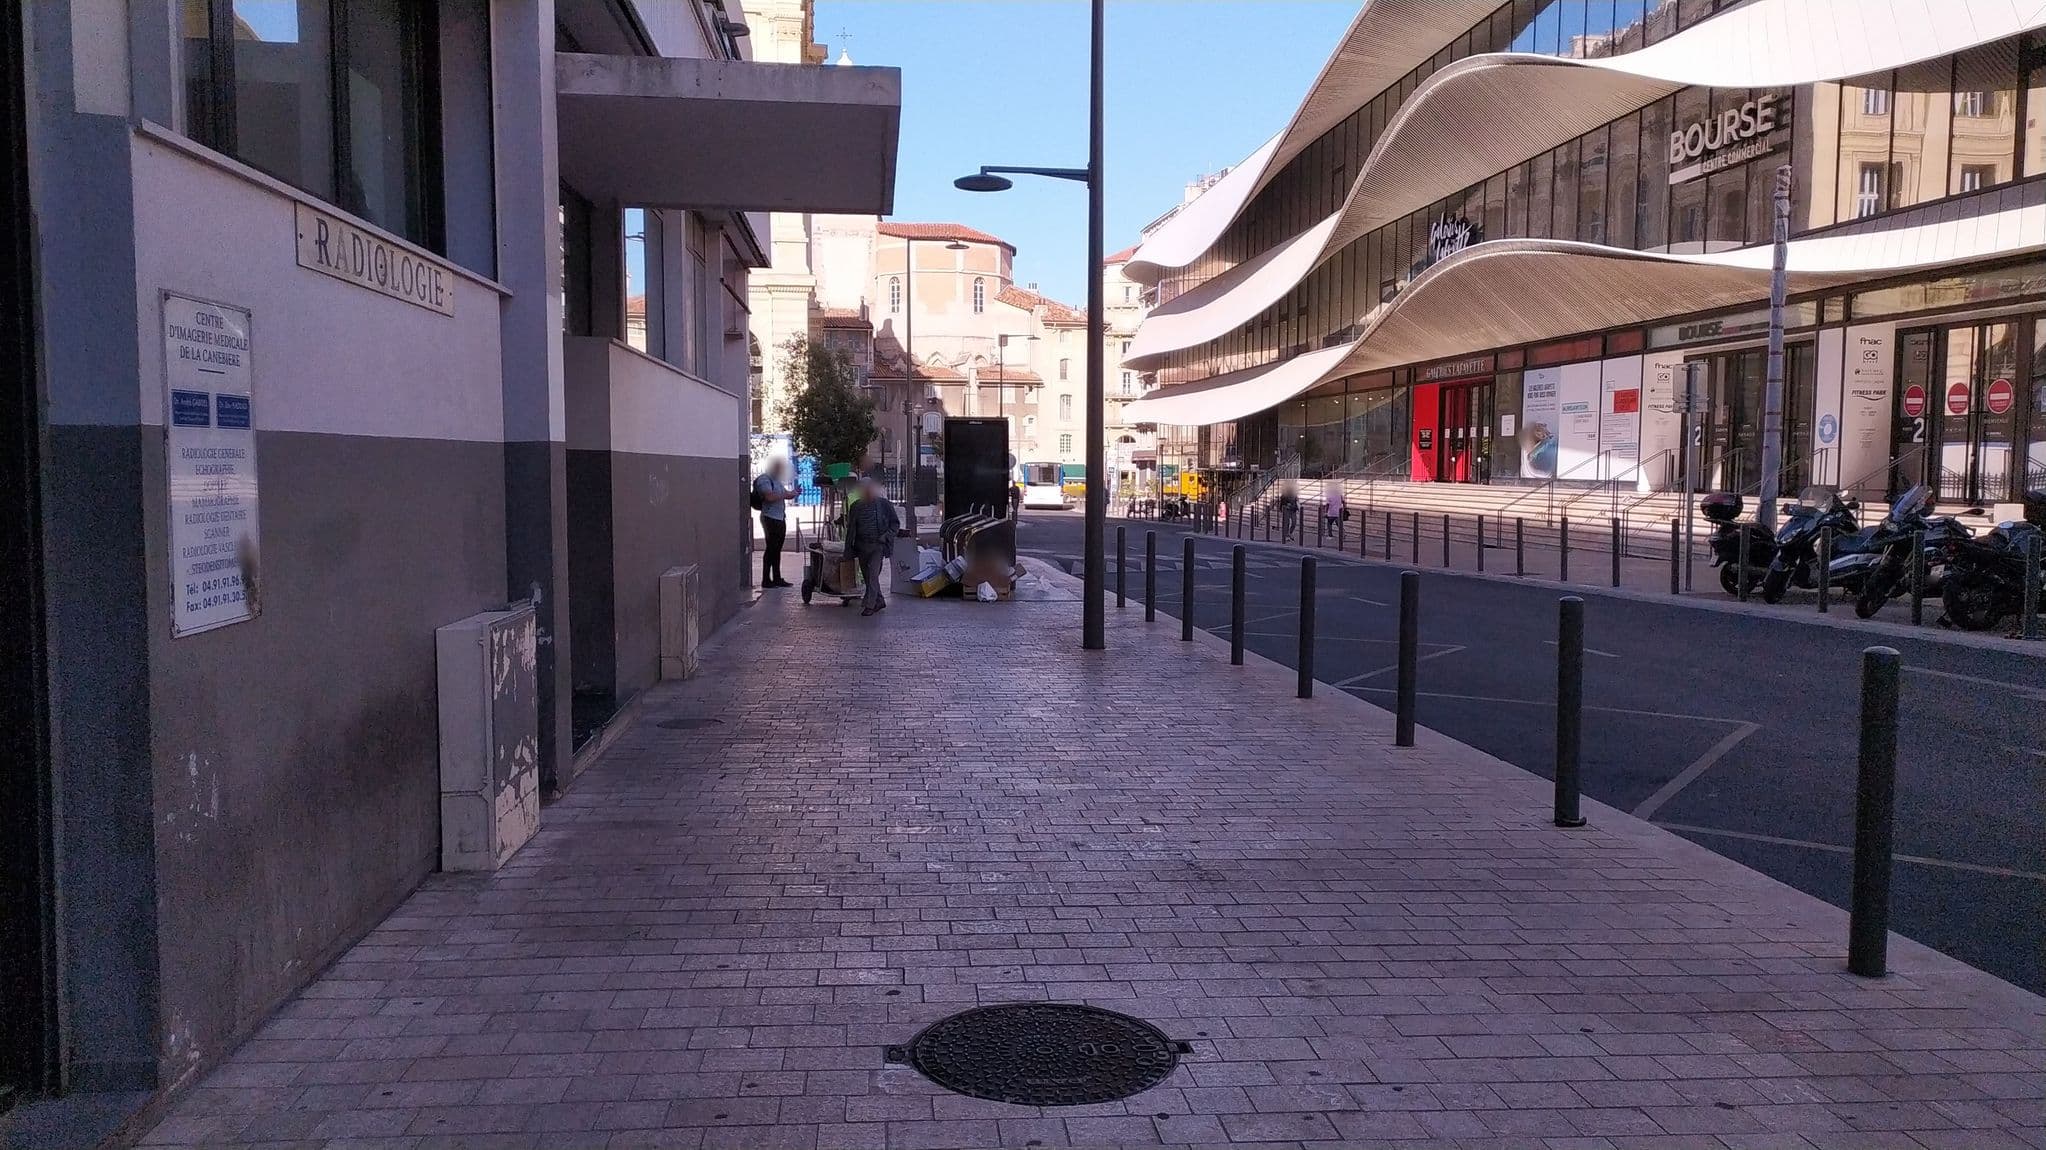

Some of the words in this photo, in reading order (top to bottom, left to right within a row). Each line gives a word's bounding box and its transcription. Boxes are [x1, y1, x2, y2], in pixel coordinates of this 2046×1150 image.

[1670, 95, 1775, 164] BOURSE
[1702, 156, 1728, 173] CENTRE
[1727, 136, 1773, 165] COMMERCIAL
[316, 217, 444, 307] RADIOLOGIE
[196, 312, 224, 330] CENTRE
[169, 325, 213, 346] D'IMAGERIE
[214, 335, 249, 351] MEDICALE
[1859, 337, 1882, 345] fnac
[180, 345, 190, 359] DE
[191, 349, 201, 361] LA
[1694, 425, 1702, 446] 2
[1912, 417, 1924, 443] 2
[203, 526, 230, 539] SCANNER
[185, 583, 199, 596] Tél:
[186, 601, 202, 613] Fax:
